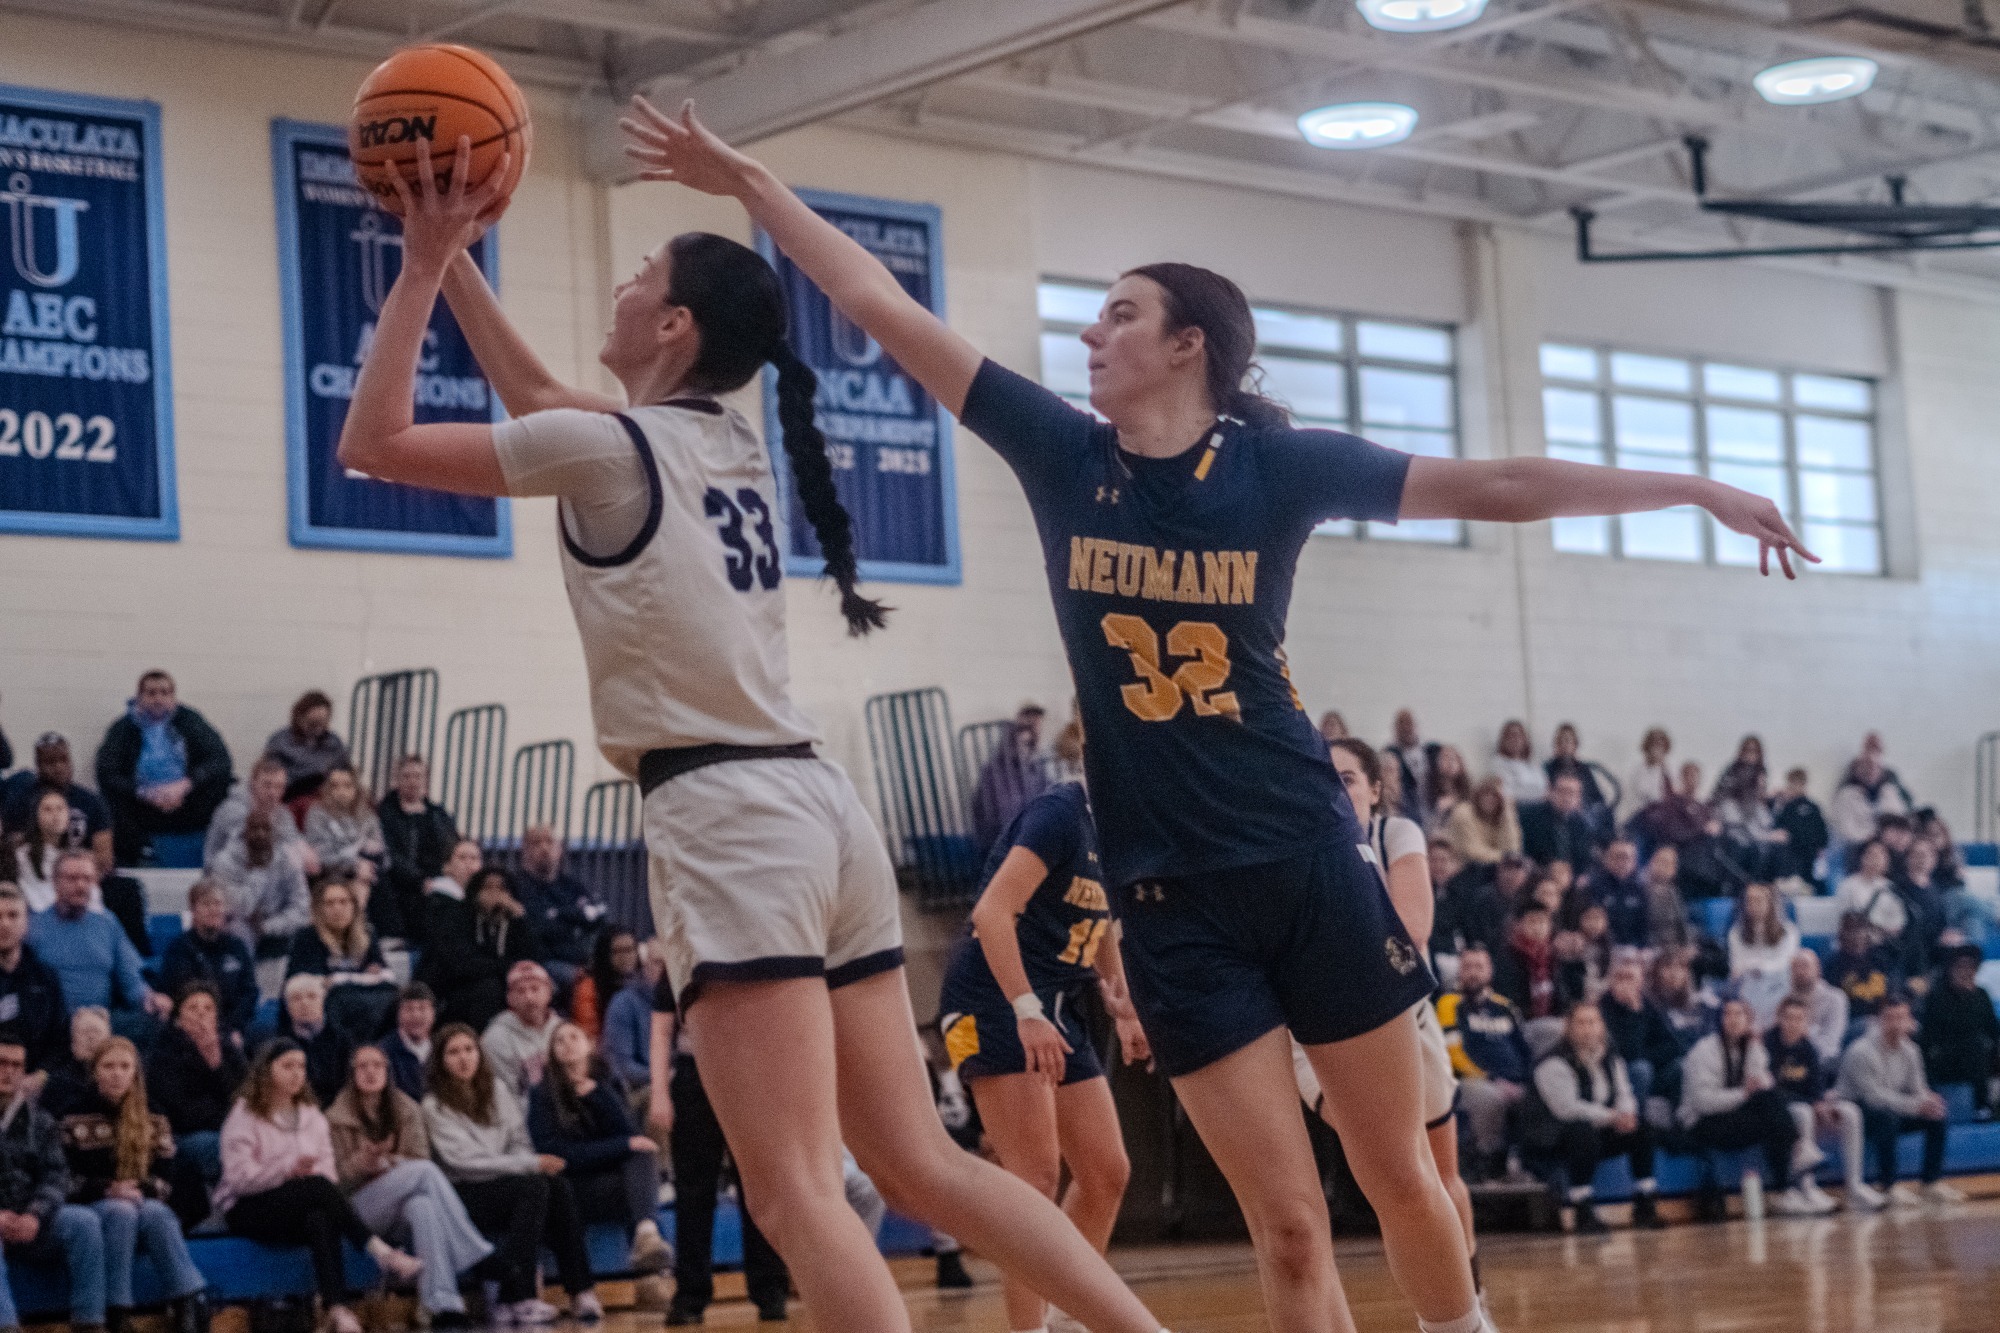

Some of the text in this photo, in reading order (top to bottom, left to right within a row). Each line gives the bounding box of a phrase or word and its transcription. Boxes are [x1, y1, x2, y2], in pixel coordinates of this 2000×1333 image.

[0, 113, 140, 160] ACULATA
[0, 408, 117, 463] 2022
[703, 485, 782, 592] 33
[1068, 536, 1258, 605] NEUMANN
[1101, 612, 1242, 722] 32
